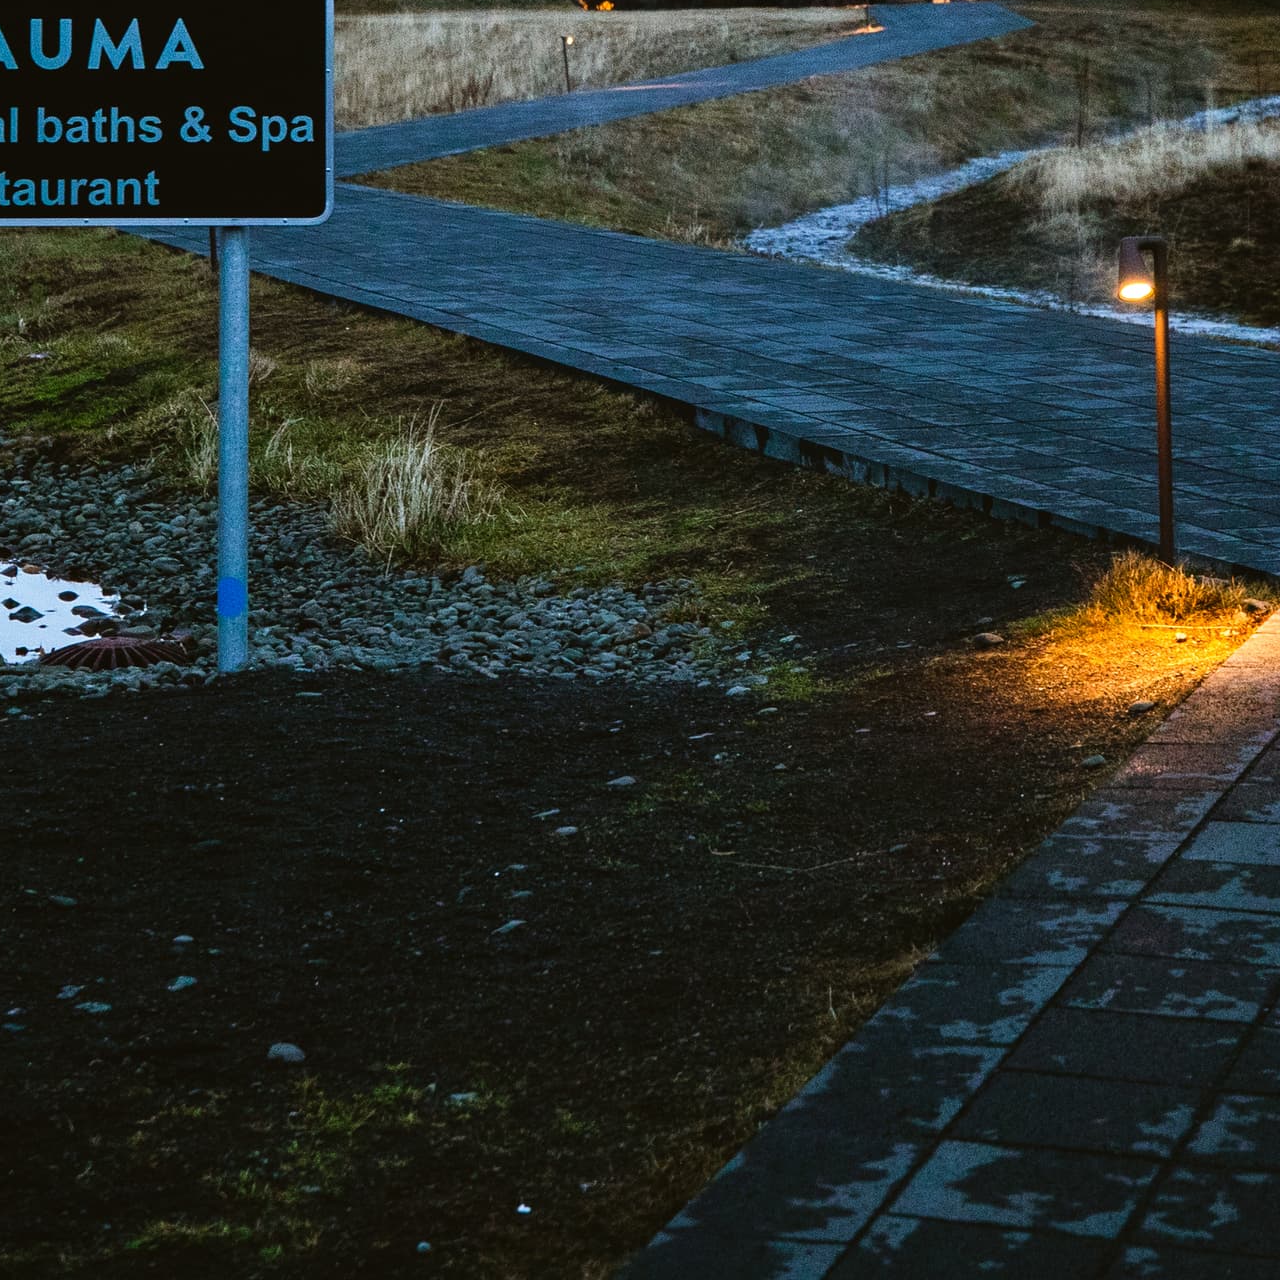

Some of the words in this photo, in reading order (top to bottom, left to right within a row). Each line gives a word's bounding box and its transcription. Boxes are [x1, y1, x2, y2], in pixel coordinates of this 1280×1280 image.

[37, 106, 163, 144] baths
[179, 106, 212, 144] &
[228, 105, 315, 152] Spa
